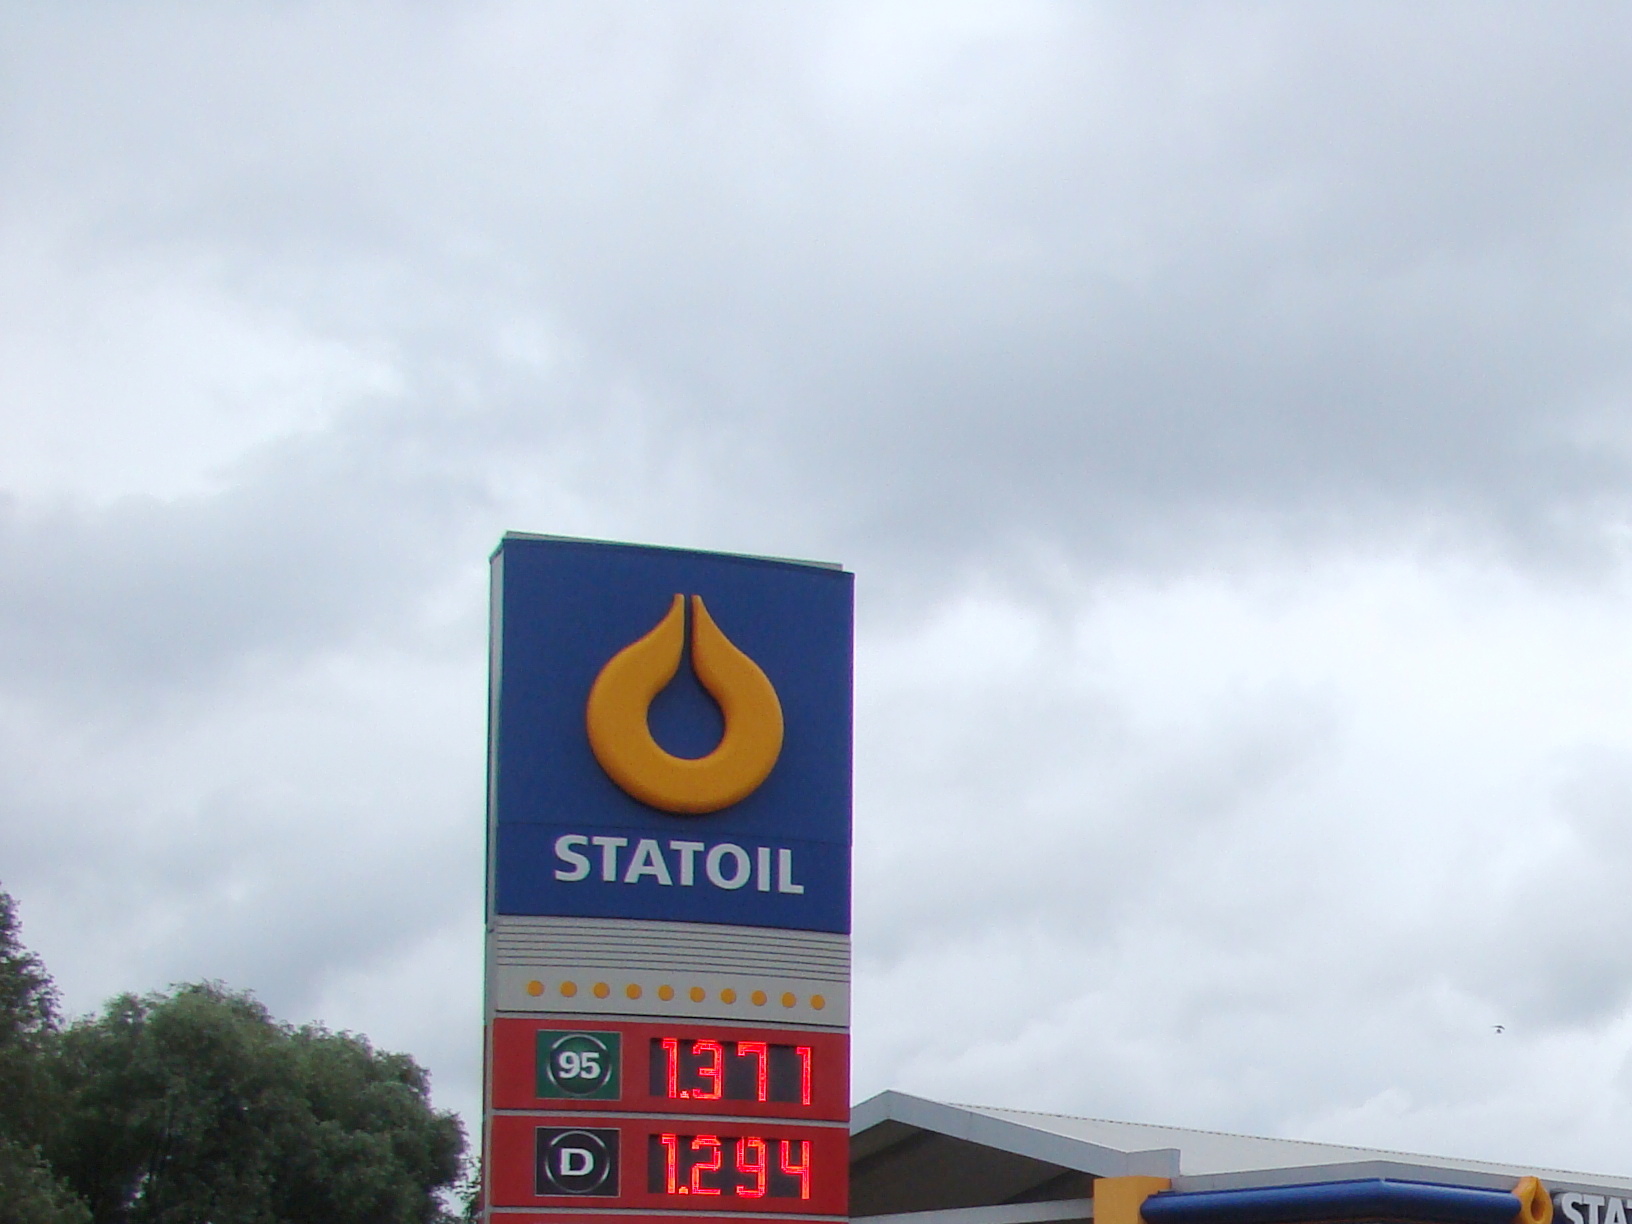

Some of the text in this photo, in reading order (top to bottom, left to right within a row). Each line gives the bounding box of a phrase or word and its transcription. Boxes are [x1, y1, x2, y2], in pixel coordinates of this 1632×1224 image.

[553, 834, 805, 894] STATOIL
[559, 1051, 601, 1079] 95
[661, 1037, 811, 1106] 1.371
[559, 1147, 594, 1177] D
[661, 1133, 810, 1199] 1.294
